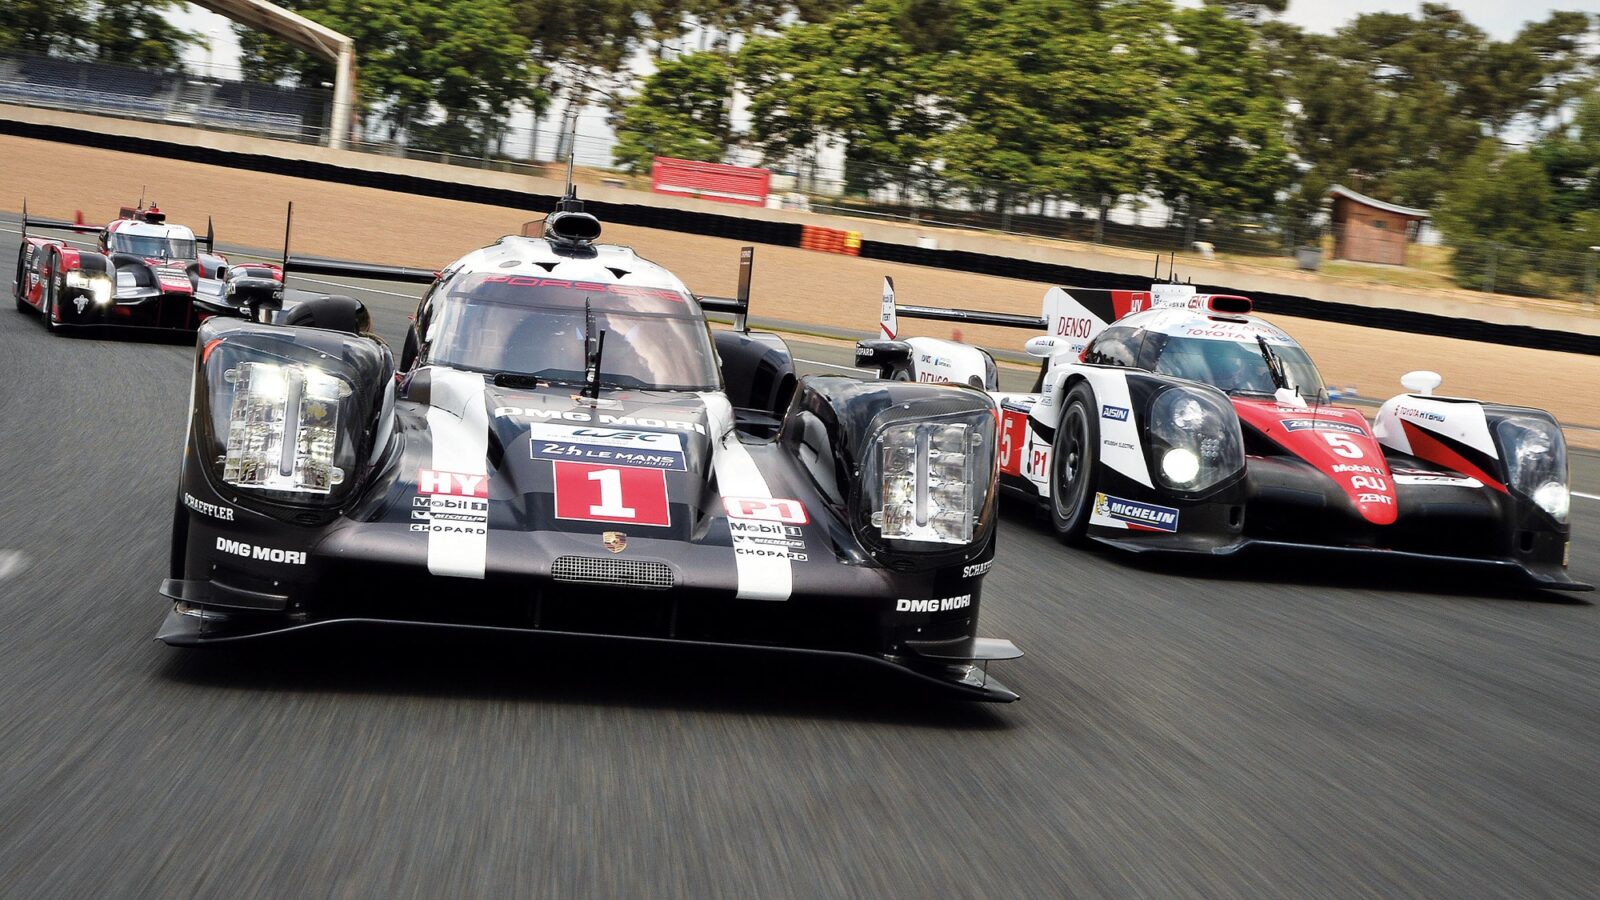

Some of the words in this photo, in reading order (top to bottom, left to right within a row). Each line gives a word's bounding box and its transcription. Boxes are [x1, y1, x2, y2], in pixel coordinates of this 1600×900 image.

[483, 276, 684, 303] PORSCHE
[1057, 316, 1092, 339] DENSO
[1186, 328, 1246, 339] TOYOTA
[494, 406, 592, 422] DMG
[599, 414, 707, 435] MORI
[1103, 406, 1128, 420] AISIN
[572, 429, 663, 442] WEC
[1001, 418, 1013, 467] 5
[1322, 432, 1364, 459] 5
[586, 450, 613, 459] LE
[615, 452, 675, 464] MANS
[1033, 450, 1047, 477] P1
[1331, 463, 1373, 473] Mobil
[420, 470, 485, 496] HY
[587, 468, 636, 519] 1
[1356, 493, 1393, 505] ZENT
[184, 492, 234, 521] SCHAEFFLER
[414, 497, 467, 509] Mobil
[739, 501, 792, 518] P1
[1110, 502, 1177, 524] MICHELIN
[411, 524, 486, 535] CHOPARD
[730, 522, 782, 534] Mobil
[216, 536, 251, 557] DMG
[252, 546, 307, 565] MORI
[736, 548, 806, 561] CHOPARD
[896, 598, 940, 612] DMG
[940, 594, 971, 612] MORI
